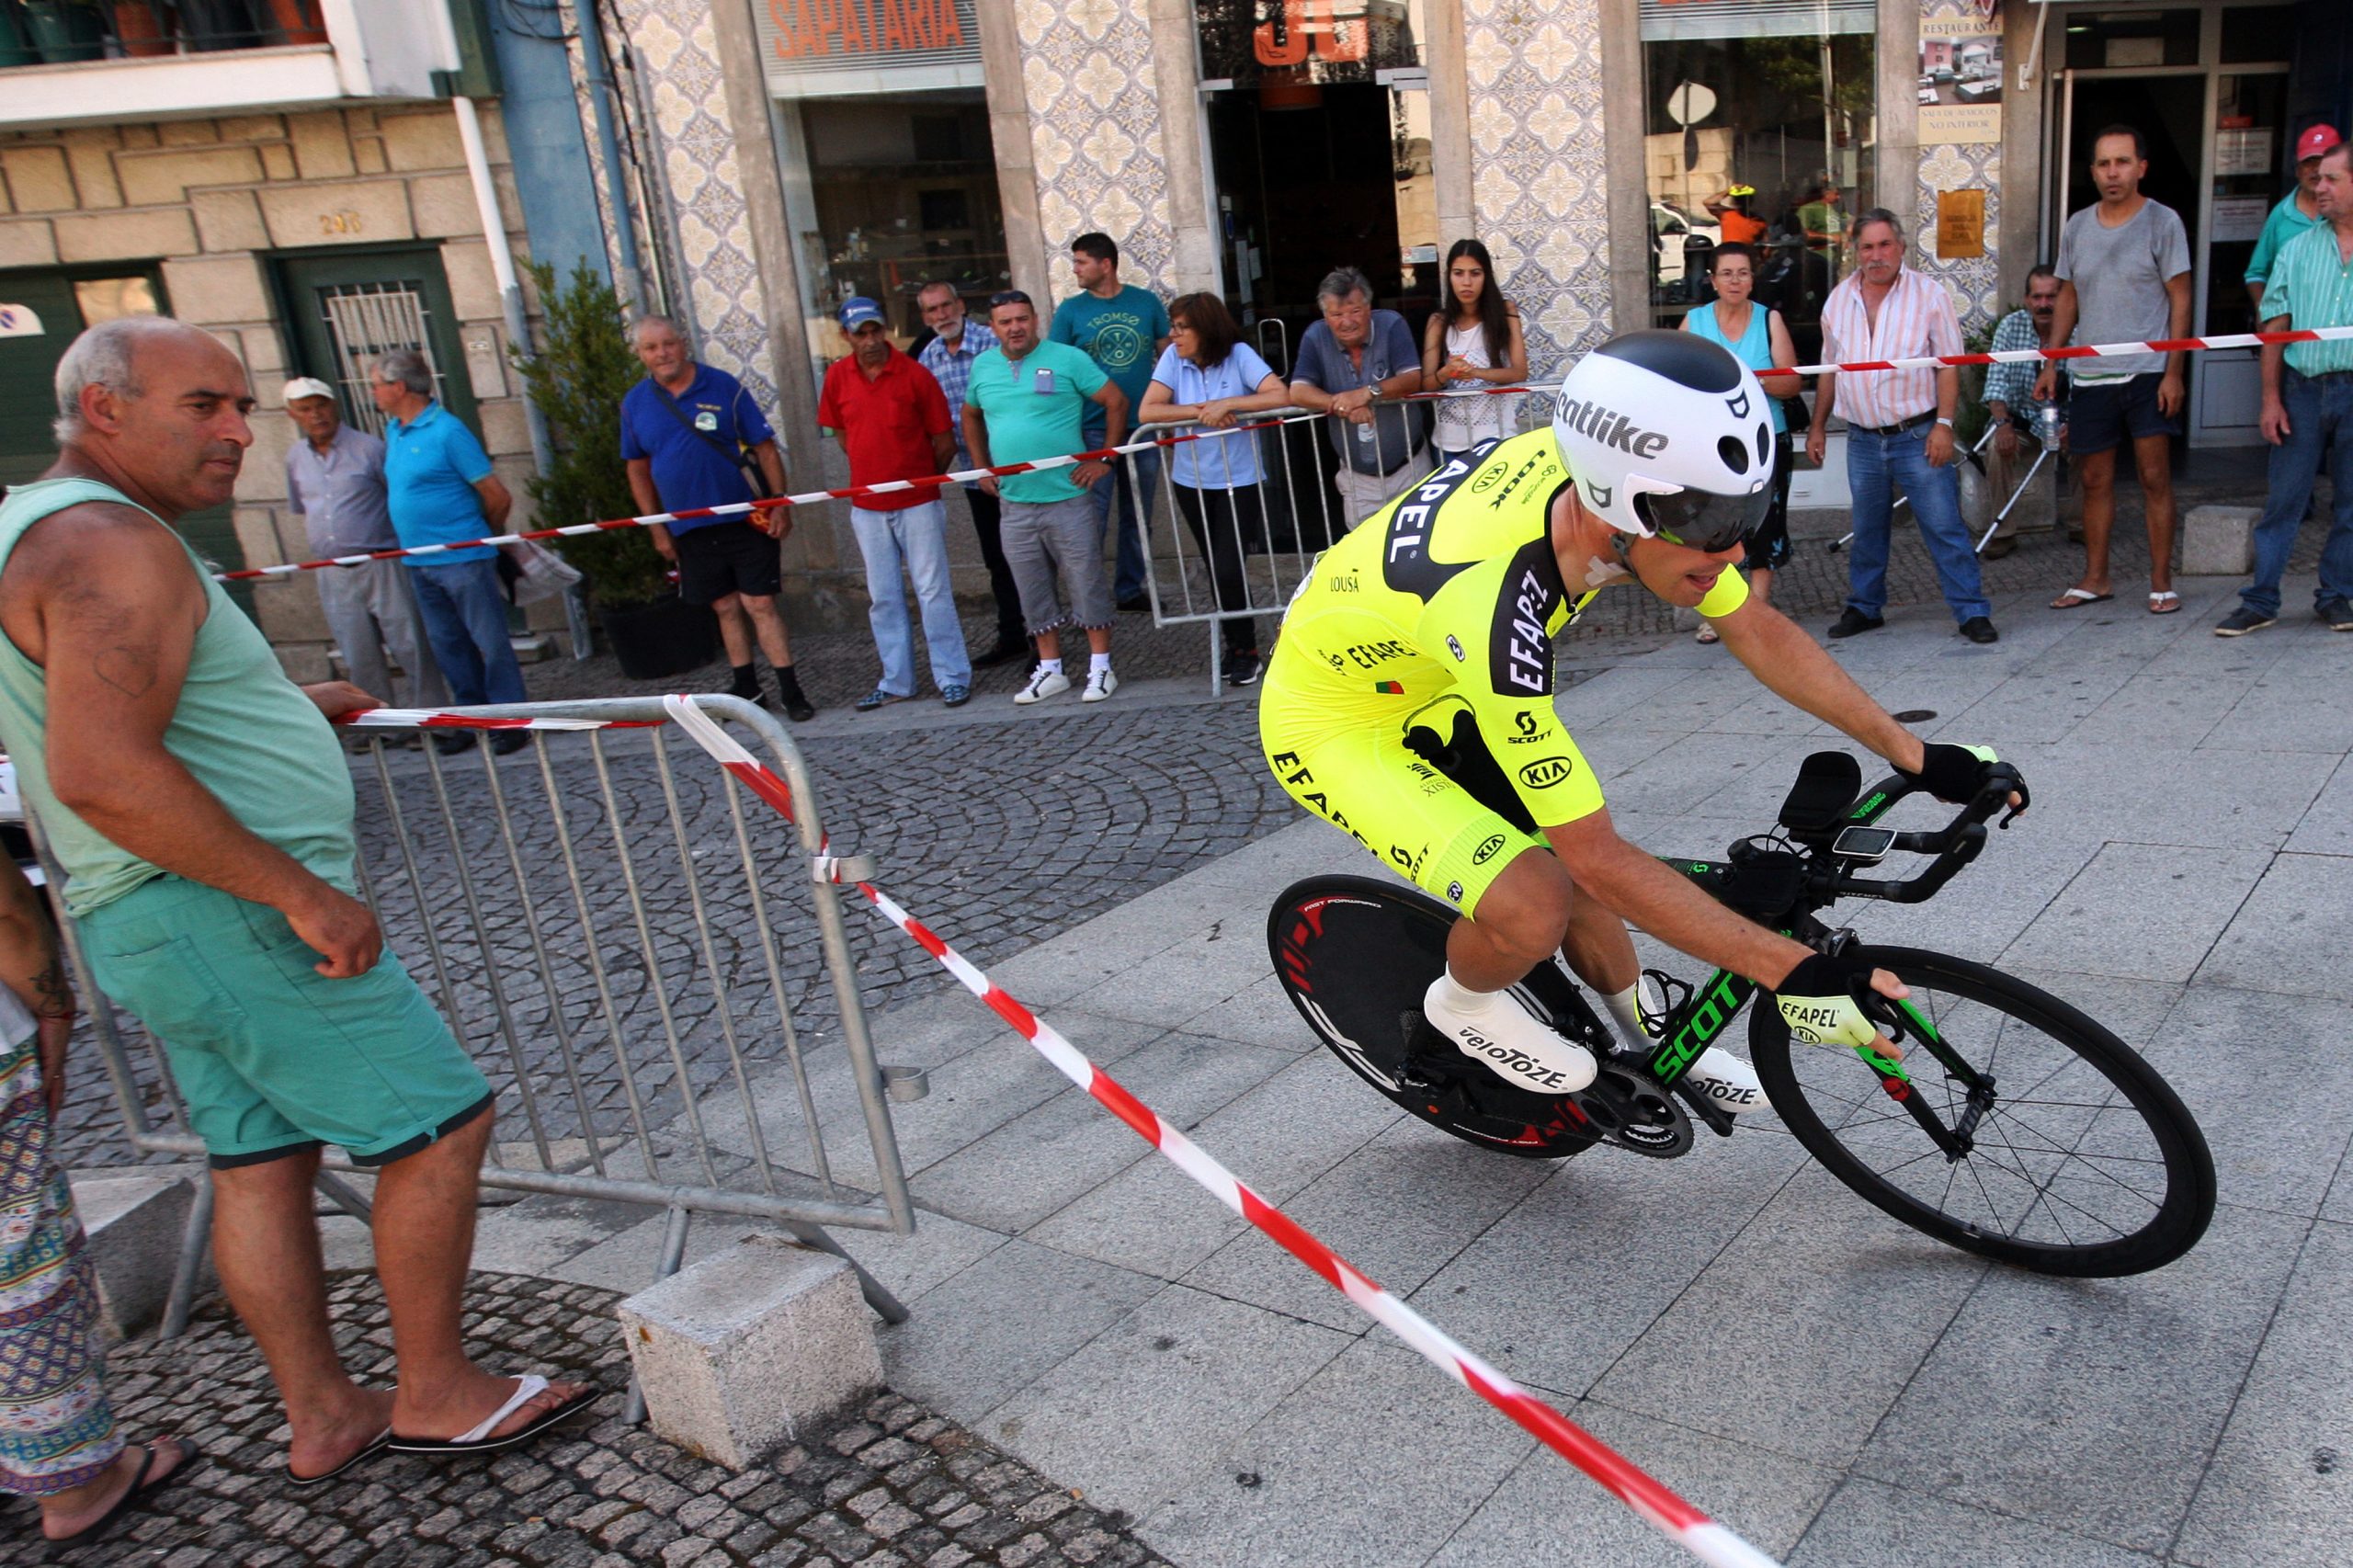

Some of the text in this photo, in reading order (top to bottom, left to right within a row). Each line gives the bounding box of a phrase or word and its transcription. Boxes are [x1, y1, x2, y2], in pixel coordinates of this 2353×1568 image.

[1923, 22, 2000, 34] RESTAURANTE
[1086, 312, 1140, 329] TROMSØ
[1556, 391, 1669, 460] catlike
[1475, 468, 1504, 489] KIA
[1489, 449, 1546, 512] LOOK
[1330, 568, 1359, 593] LOUSÃ
[1507, 728, 1552, 744] SCOTT
[1526, 761, 1566, 785] KIA
[1476, 838, 1502, 860] KIA
[1781, 1002, 1837, 1028] EFAPEL
[1654, 971, 1755, 1085] SCOT
[1798, 1028, 1815, 1043] KIA
